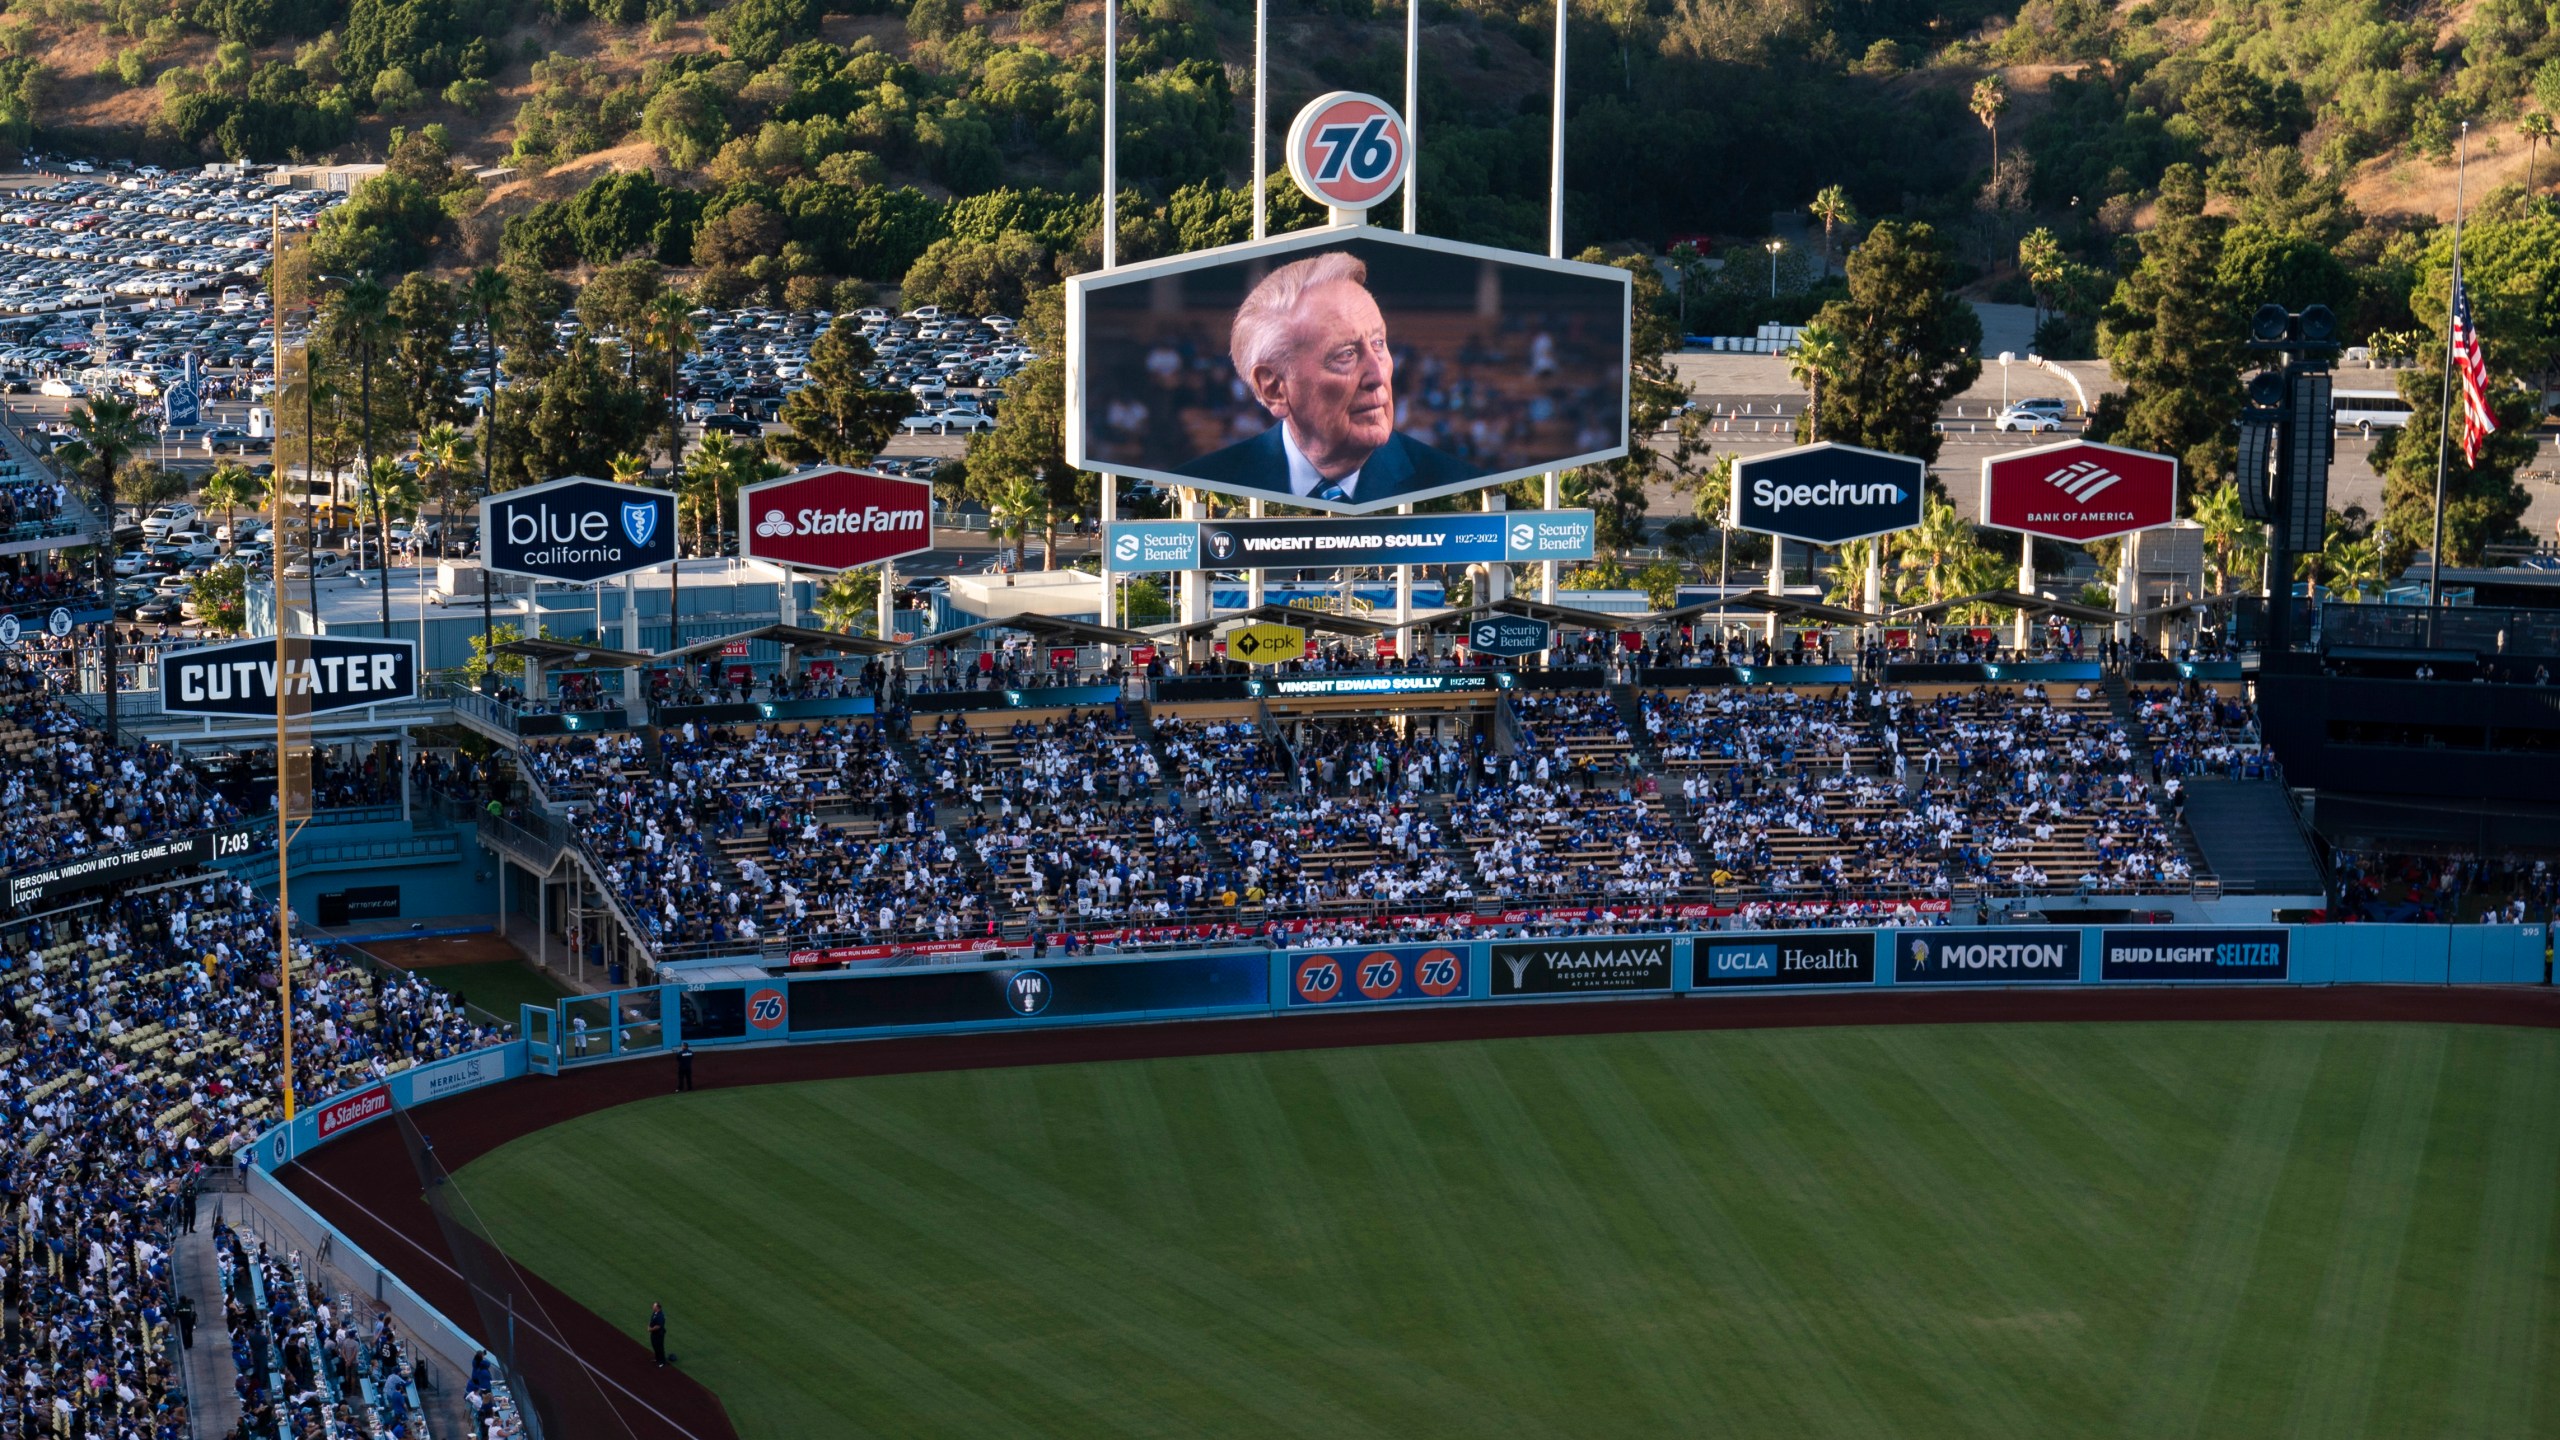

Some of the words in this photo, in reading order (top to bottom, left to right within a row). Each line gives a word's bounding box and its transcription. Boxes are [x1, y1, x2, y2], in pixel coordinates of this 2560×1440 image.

[1312, 114, 1392, 183] 76
[1753, 478, 1898, 513] Spectrum
[507, 503, 609, 545] blue
[2028, 513, 2060, 522] BANK
[2062, 512, 2078, 522] OF
[2080, 512, 2134, 521] AMERICA
[1538, 522, 1588, 538] Security
[1144, 532, 1195, 548] Security
[1214, 536, 1230, 546] VIN
[1243, 536, 1314, 550] VINCENT
[1315, 534, 1382, 550] EDWARD
[1385, 533, 1446, 548] SCULLY
[1455, 534, 1498, 544] 1927-2022
[1539, 536, 1582, 550] Benefit
[524, 546, 621, 565] california
[1144, 547, 1188, 560] Benefit
[1500, 624, 1542, 638] Security
[1263, 634, 1295, 652] cpk
[1500, 636, 1536, 647] Benefit
[180, 653, 396, 702] CUTWATER
[1278, 680, 1334, 692] VINCENT
[1336, 678, 1391, 691] EDWARD
[1392, 677, 1442, 689] SCULLY
[220, 832, 249, 855] 7:03
[14, 870, 60, 892] PERSONAL
[60, 860, 97, 878] WINDOW
[98, 856, 119, 869] INTO
[121, 850, 140, 865] THE
[141, 845, 168, 860] GAME.
[170, 840, 193, 854] HOW
[15, 886, 43, 904] LUCKY
[2522, 928, 2539, 936] 395
[1675, 937, 1691, 946] 375
[1544, 944, 1666, 970] YAAMAVA'
[1718, 952, 1769, 970] UCLA
[1783, 948, 1858, 970] Health
[1941, 944, 2063, 969] MORTON
[2110, 947, 2153, 963] BUD
[2155, 947, 2214, 962] LIGHT
[2216, 943, 2280, 966] SELTZER
[1302, 963, 1336, 992] 76
[1362, 960, 1397, 989] 76
[1421, 957, 1456, 986] 76
[688, 983, 705, 992] 360
[1016, 978, 1041, 994] VIN
[752, 996, 782, 1021] 76
[430, 1072, 466, 1088] MERRILL
[305, 1115, 314, 1126] 330
